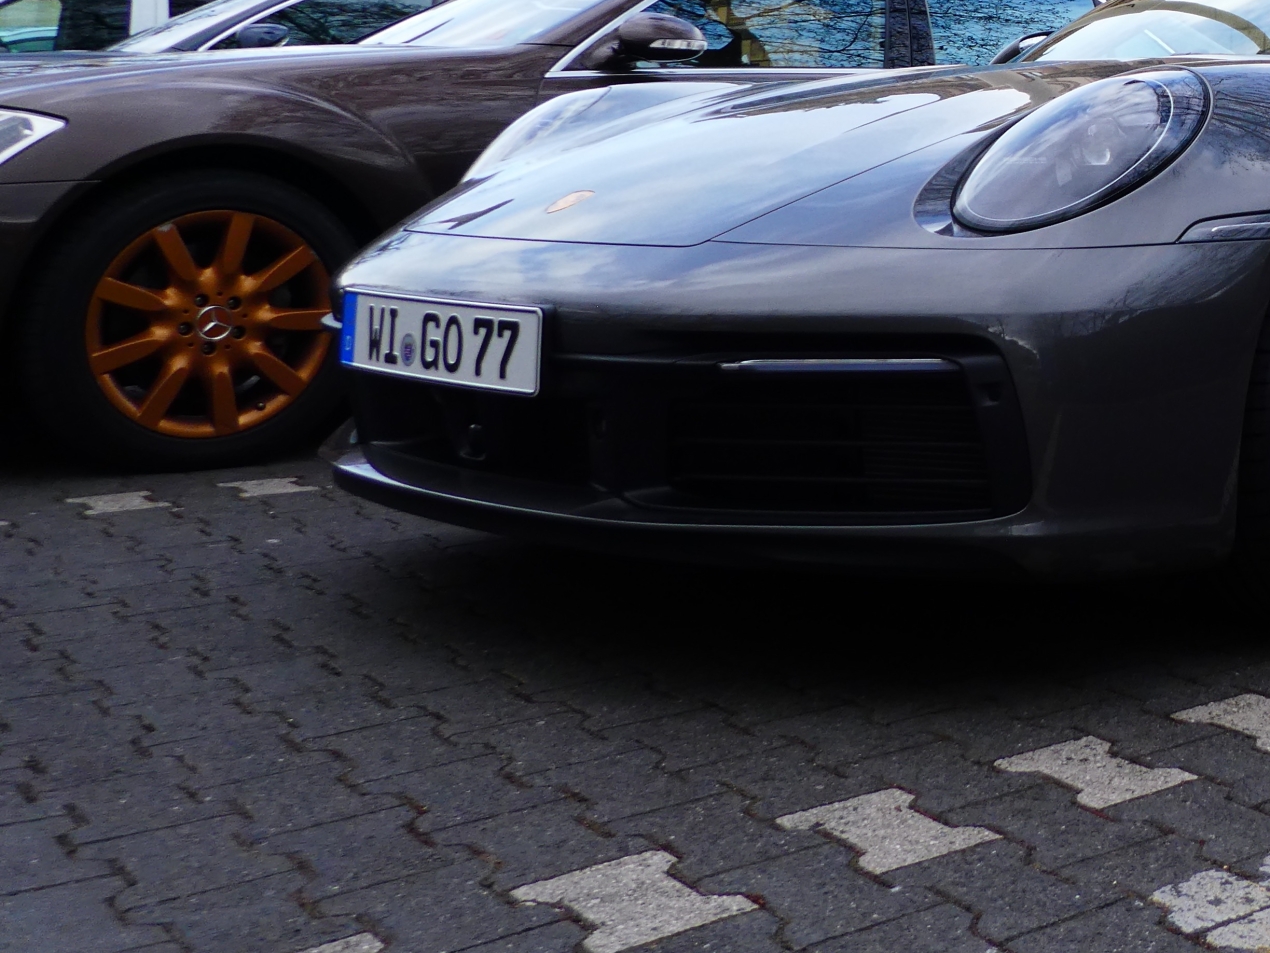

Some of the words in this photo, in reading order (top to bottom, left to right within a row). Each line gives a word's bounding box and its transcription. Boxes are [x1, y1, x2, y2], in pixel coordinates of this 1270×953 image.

[368, 304, 399, 365] WI
[420, 311, 463, 374] GO
[473, 316, 521, 380] 77
